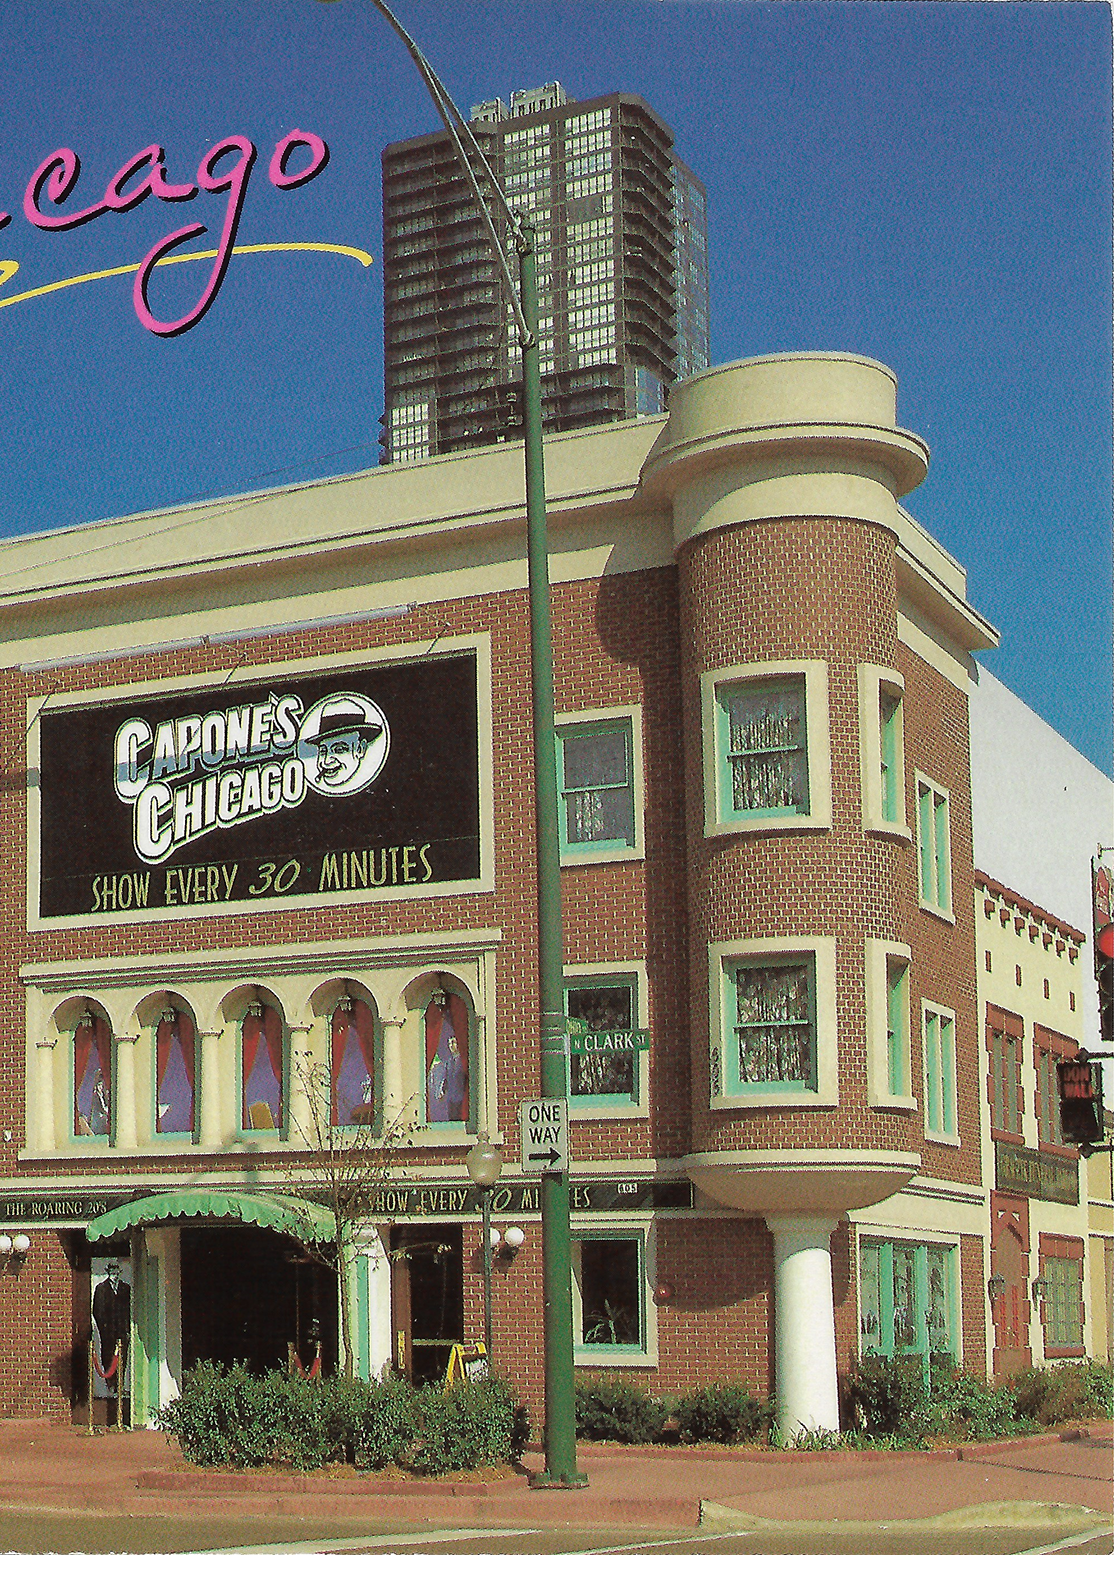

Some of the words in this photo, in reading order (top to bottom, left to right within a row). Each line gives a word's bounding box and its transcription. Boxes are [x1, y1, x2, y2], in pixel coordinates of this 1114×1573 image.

[114, 691, 306, 804] CAPONE'S
[133, 756, 308, 865] CHICAGO
[91, 872, 151, 912] SHOW
[165, 864, 239, 905] EVERY
[249, 859, 301, 895] 30
[318, 844, 433, 892] MINUTES
[574, 1039, 581, 1050] N
[584, 1032, 635, 1051] CLARK
[635, 1034, 646, 1044] ST
[528, 1104, 561, 1123] ONE
[528, 1126, 562, 1144] WAY
[6, 1202, 27, 1216] THE
[31, 1201, 83, 1215] ROARING
[420, 1189, 468, 1211] EVERY
